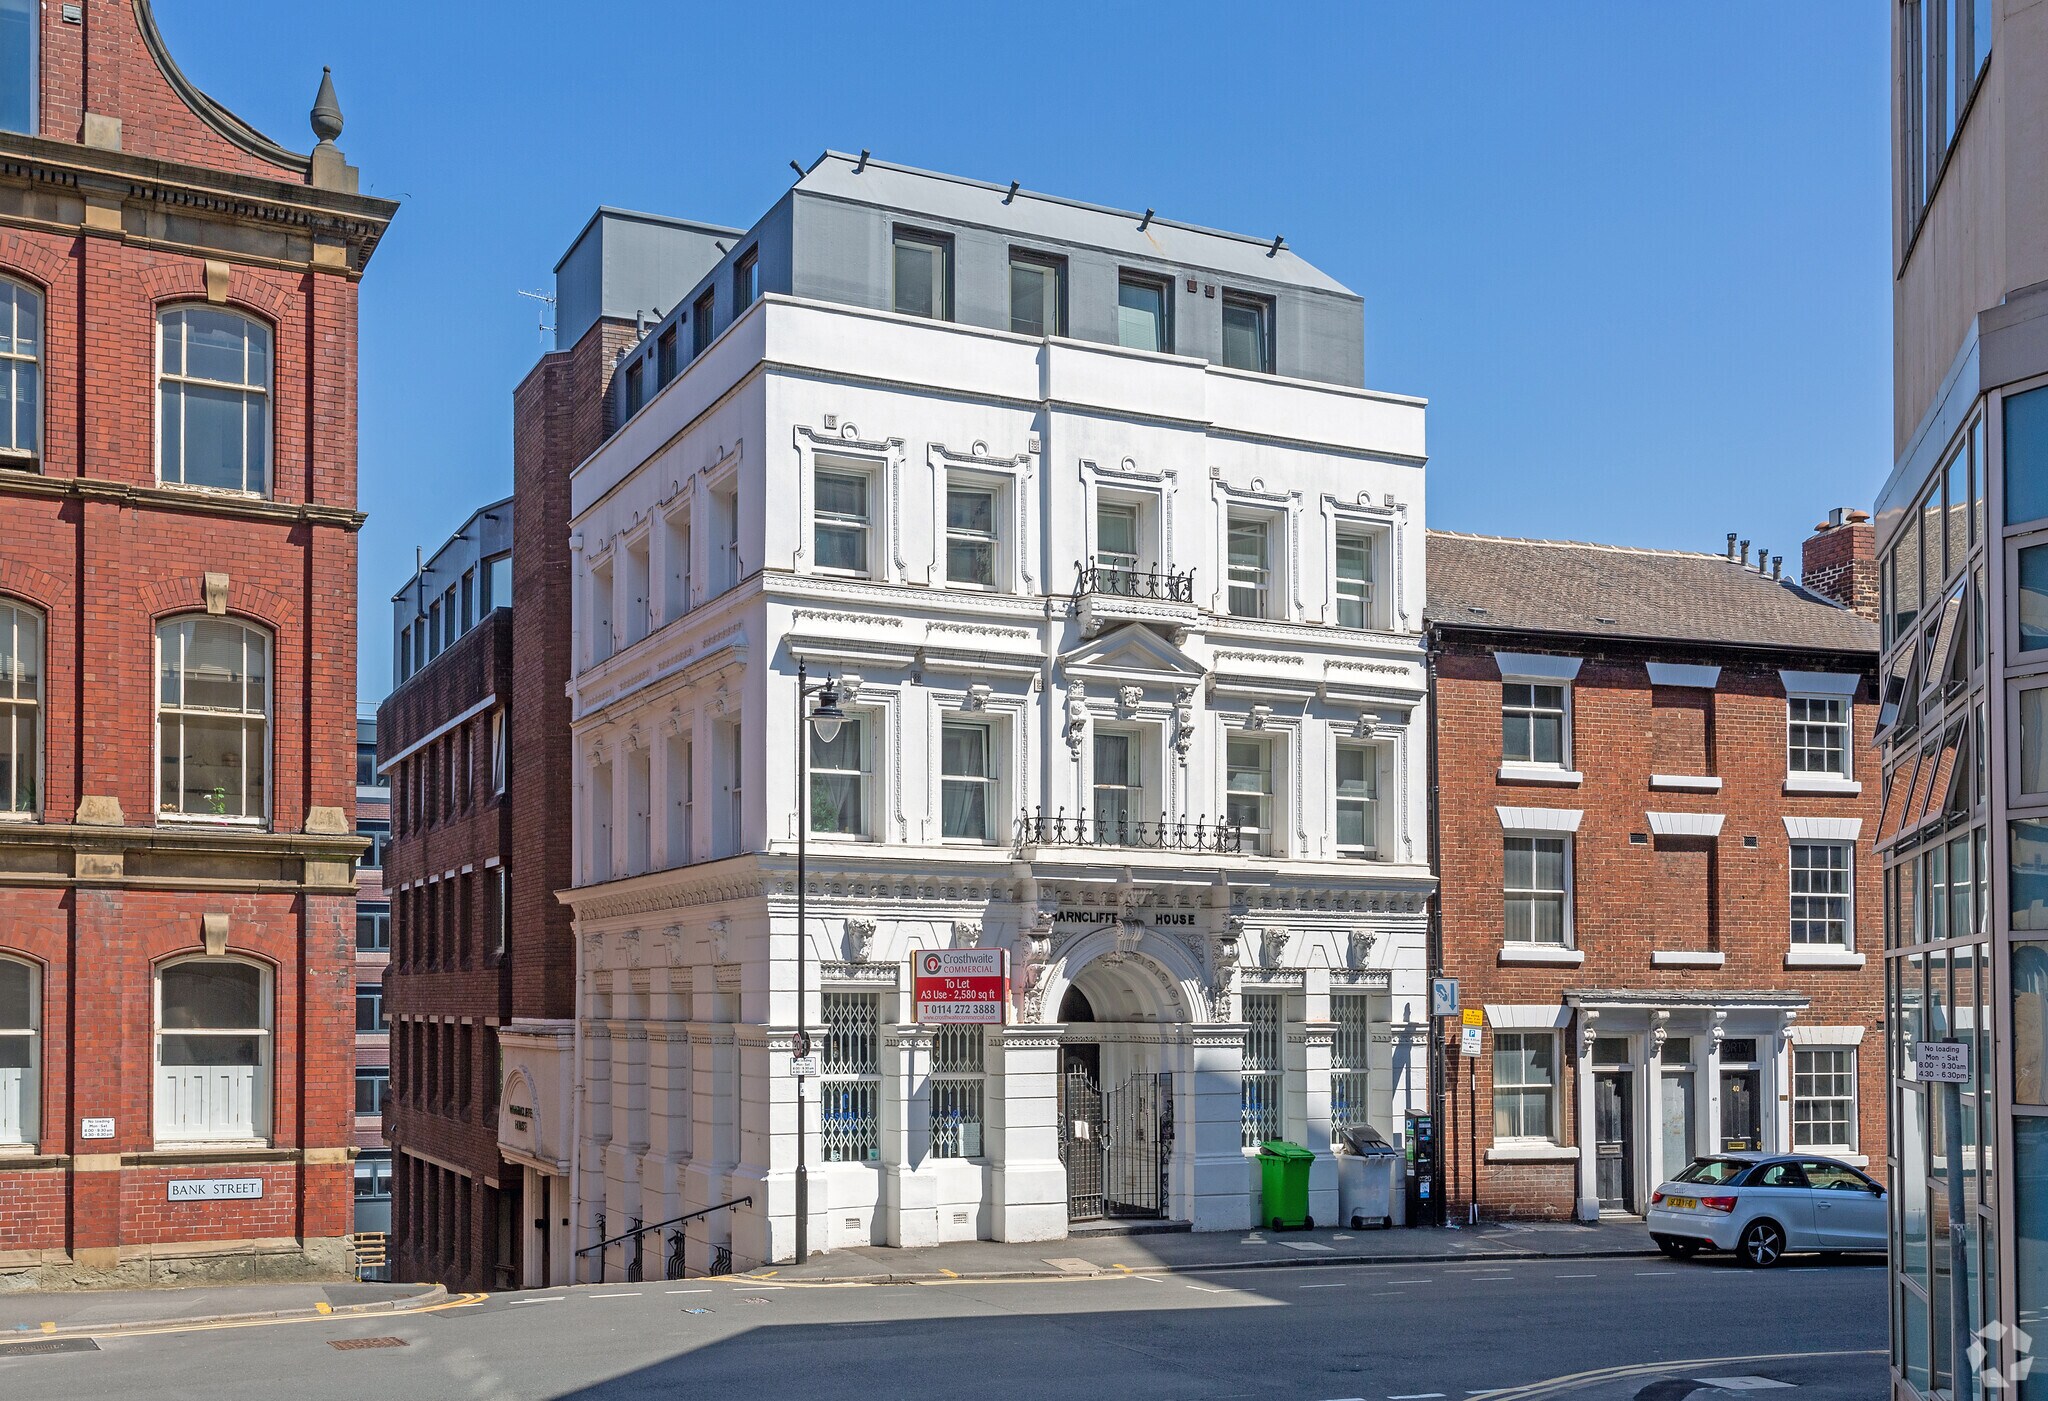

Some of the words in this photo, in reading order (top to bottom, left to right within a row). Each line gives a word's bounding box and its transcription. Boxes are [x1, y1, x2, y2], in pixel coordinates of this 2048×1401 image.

[1156, 914, 1195, 925] HOUSE
[944, 953, 993, 964] Crosthwaite
[945, 979, 954, 988] To
[957, 979, 970, 988] Let
[921, 991, 931, 999] A3
[933, 991, 947, 999] Use
[954, 990, 976, 1000] 2,580
[978, 992, 987, 1000] sq
[989, 989, 995, 999] ft
[924, 1005, 929, 1013] T
[932, 1005, 951, 1013] 0114
[955, 1005, 970, 1013] 272
[973, 1005, 995, 1013] 3888
[172, 1185, 206, 1196] BANK
[213, 1183, 256, 1194] STREET
